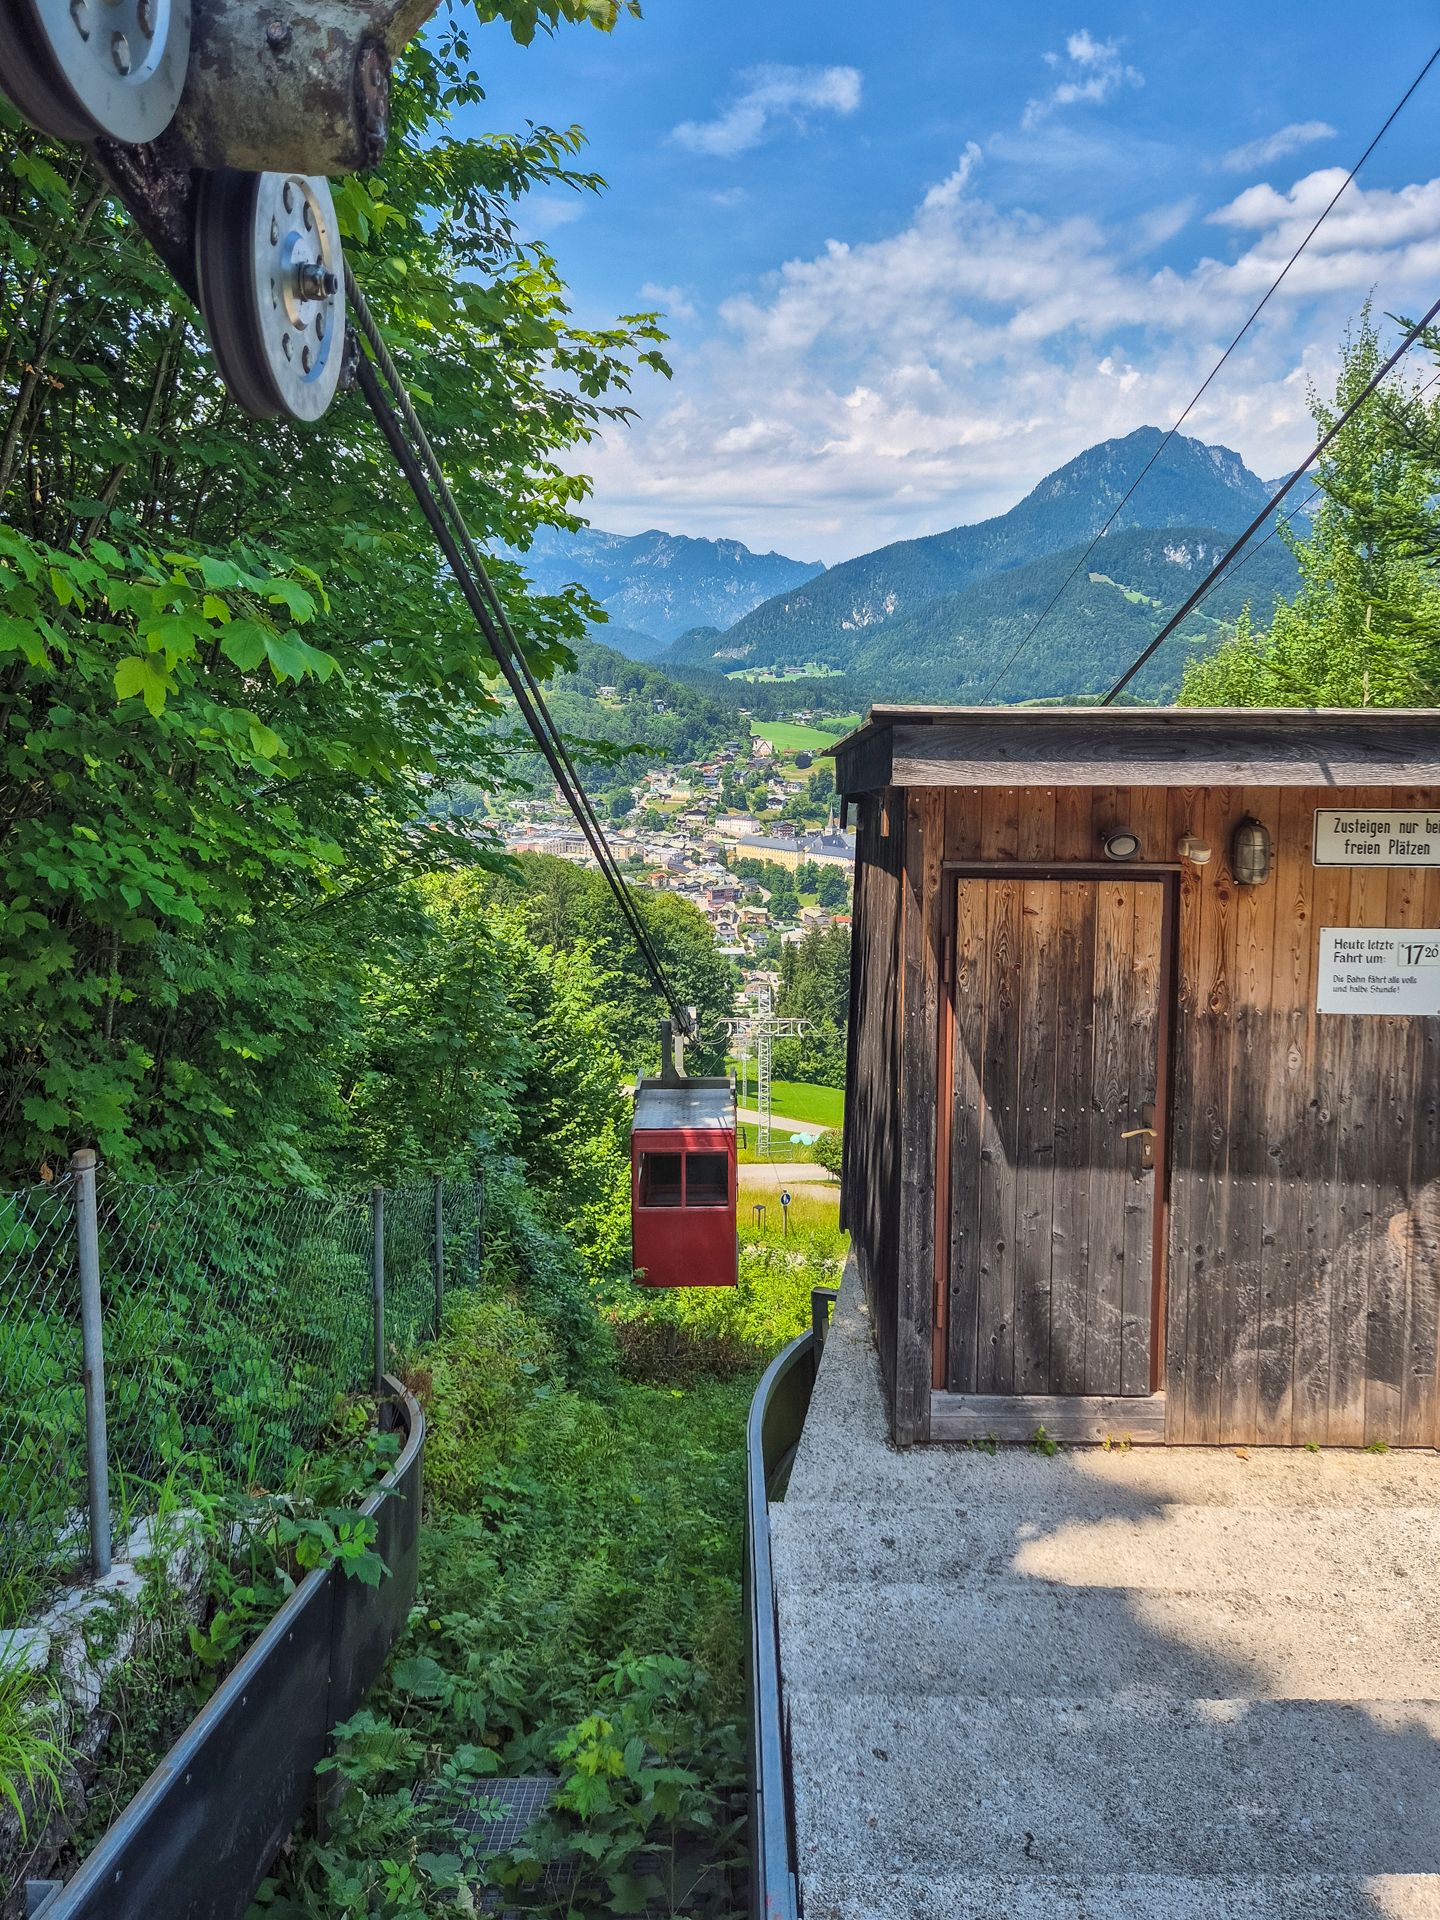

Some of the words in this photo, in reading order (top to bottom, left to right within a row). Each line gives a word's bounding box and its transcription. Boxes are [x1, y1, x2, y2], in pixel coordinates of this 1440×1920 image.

[1334, 818, 1390, 838] Zusteigen
[1400, 822, 1419, 833] nur
[1344, 839, 1380, 854] freien
[1389, 839, 1430, 855] Plätzen
[1334, 939, 1365, 950] Heute
[1368, 940, 1394, 950] letzte
[1334, 952, 1363, 963] Fahrt
[1333, 975, 1344, 983] Die
[1346, 975, 1366, 983] Bahn
[1368, 975, 1387, 984] fährt
[1333, 985, 1347, 993] und
